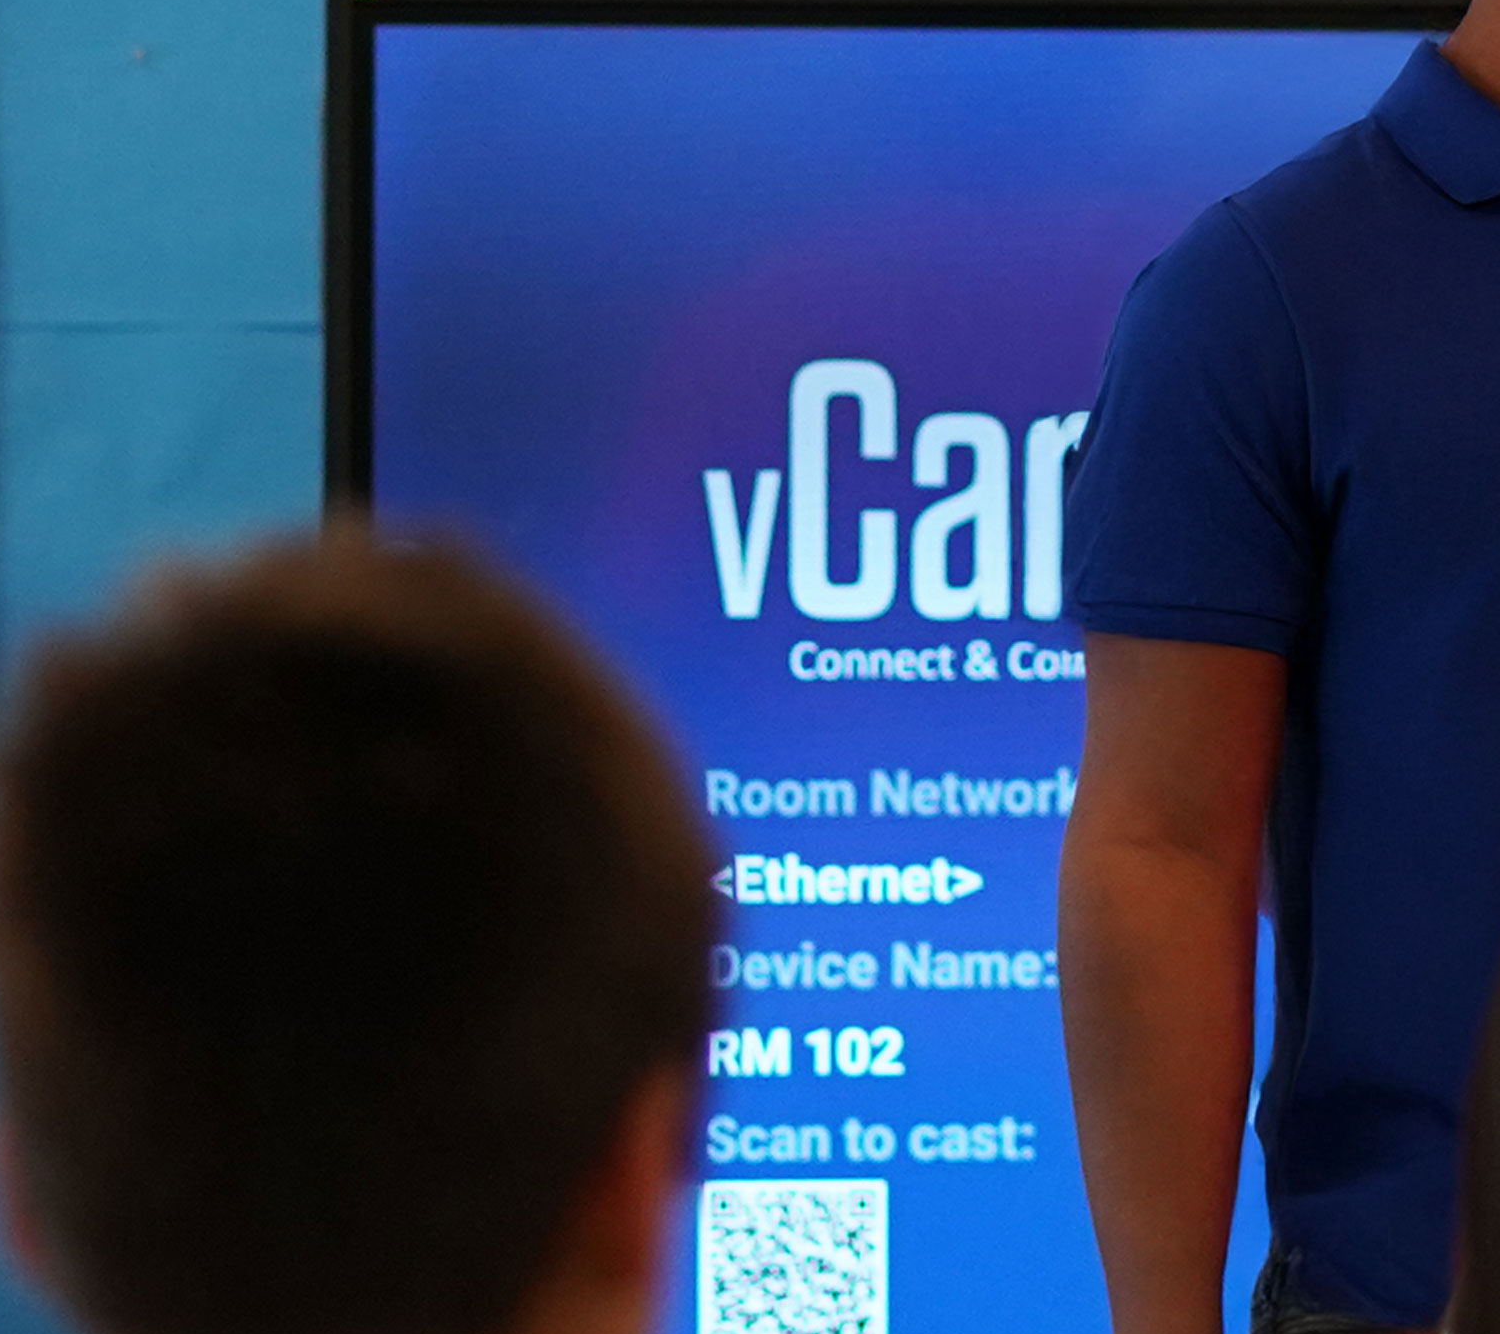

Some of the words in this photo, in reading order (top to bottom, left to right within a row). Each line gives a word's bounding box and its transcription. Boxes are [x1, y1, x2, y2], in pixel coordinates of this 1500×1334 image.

[702, 357, 1092, 621] vCar
[788, 639, 955, 681] Connect
[963, 638, 999, 681] &
[704, 768, 857, 818] Room
[869, 766, 1078, 818] Network
[710, 852, 985, 905] <Ethernet>
[708, 939, 880, 990] Device
[889, 940, 1058, 989] Name:
[706, 1025, 793, 1078] RM
[804, 1025, 906, 1077] 102
[705, 1113, 832, 1163] Scan
[842, 1116, 898, 1162] to
[908, 1114, 1037, 1163] cast:
